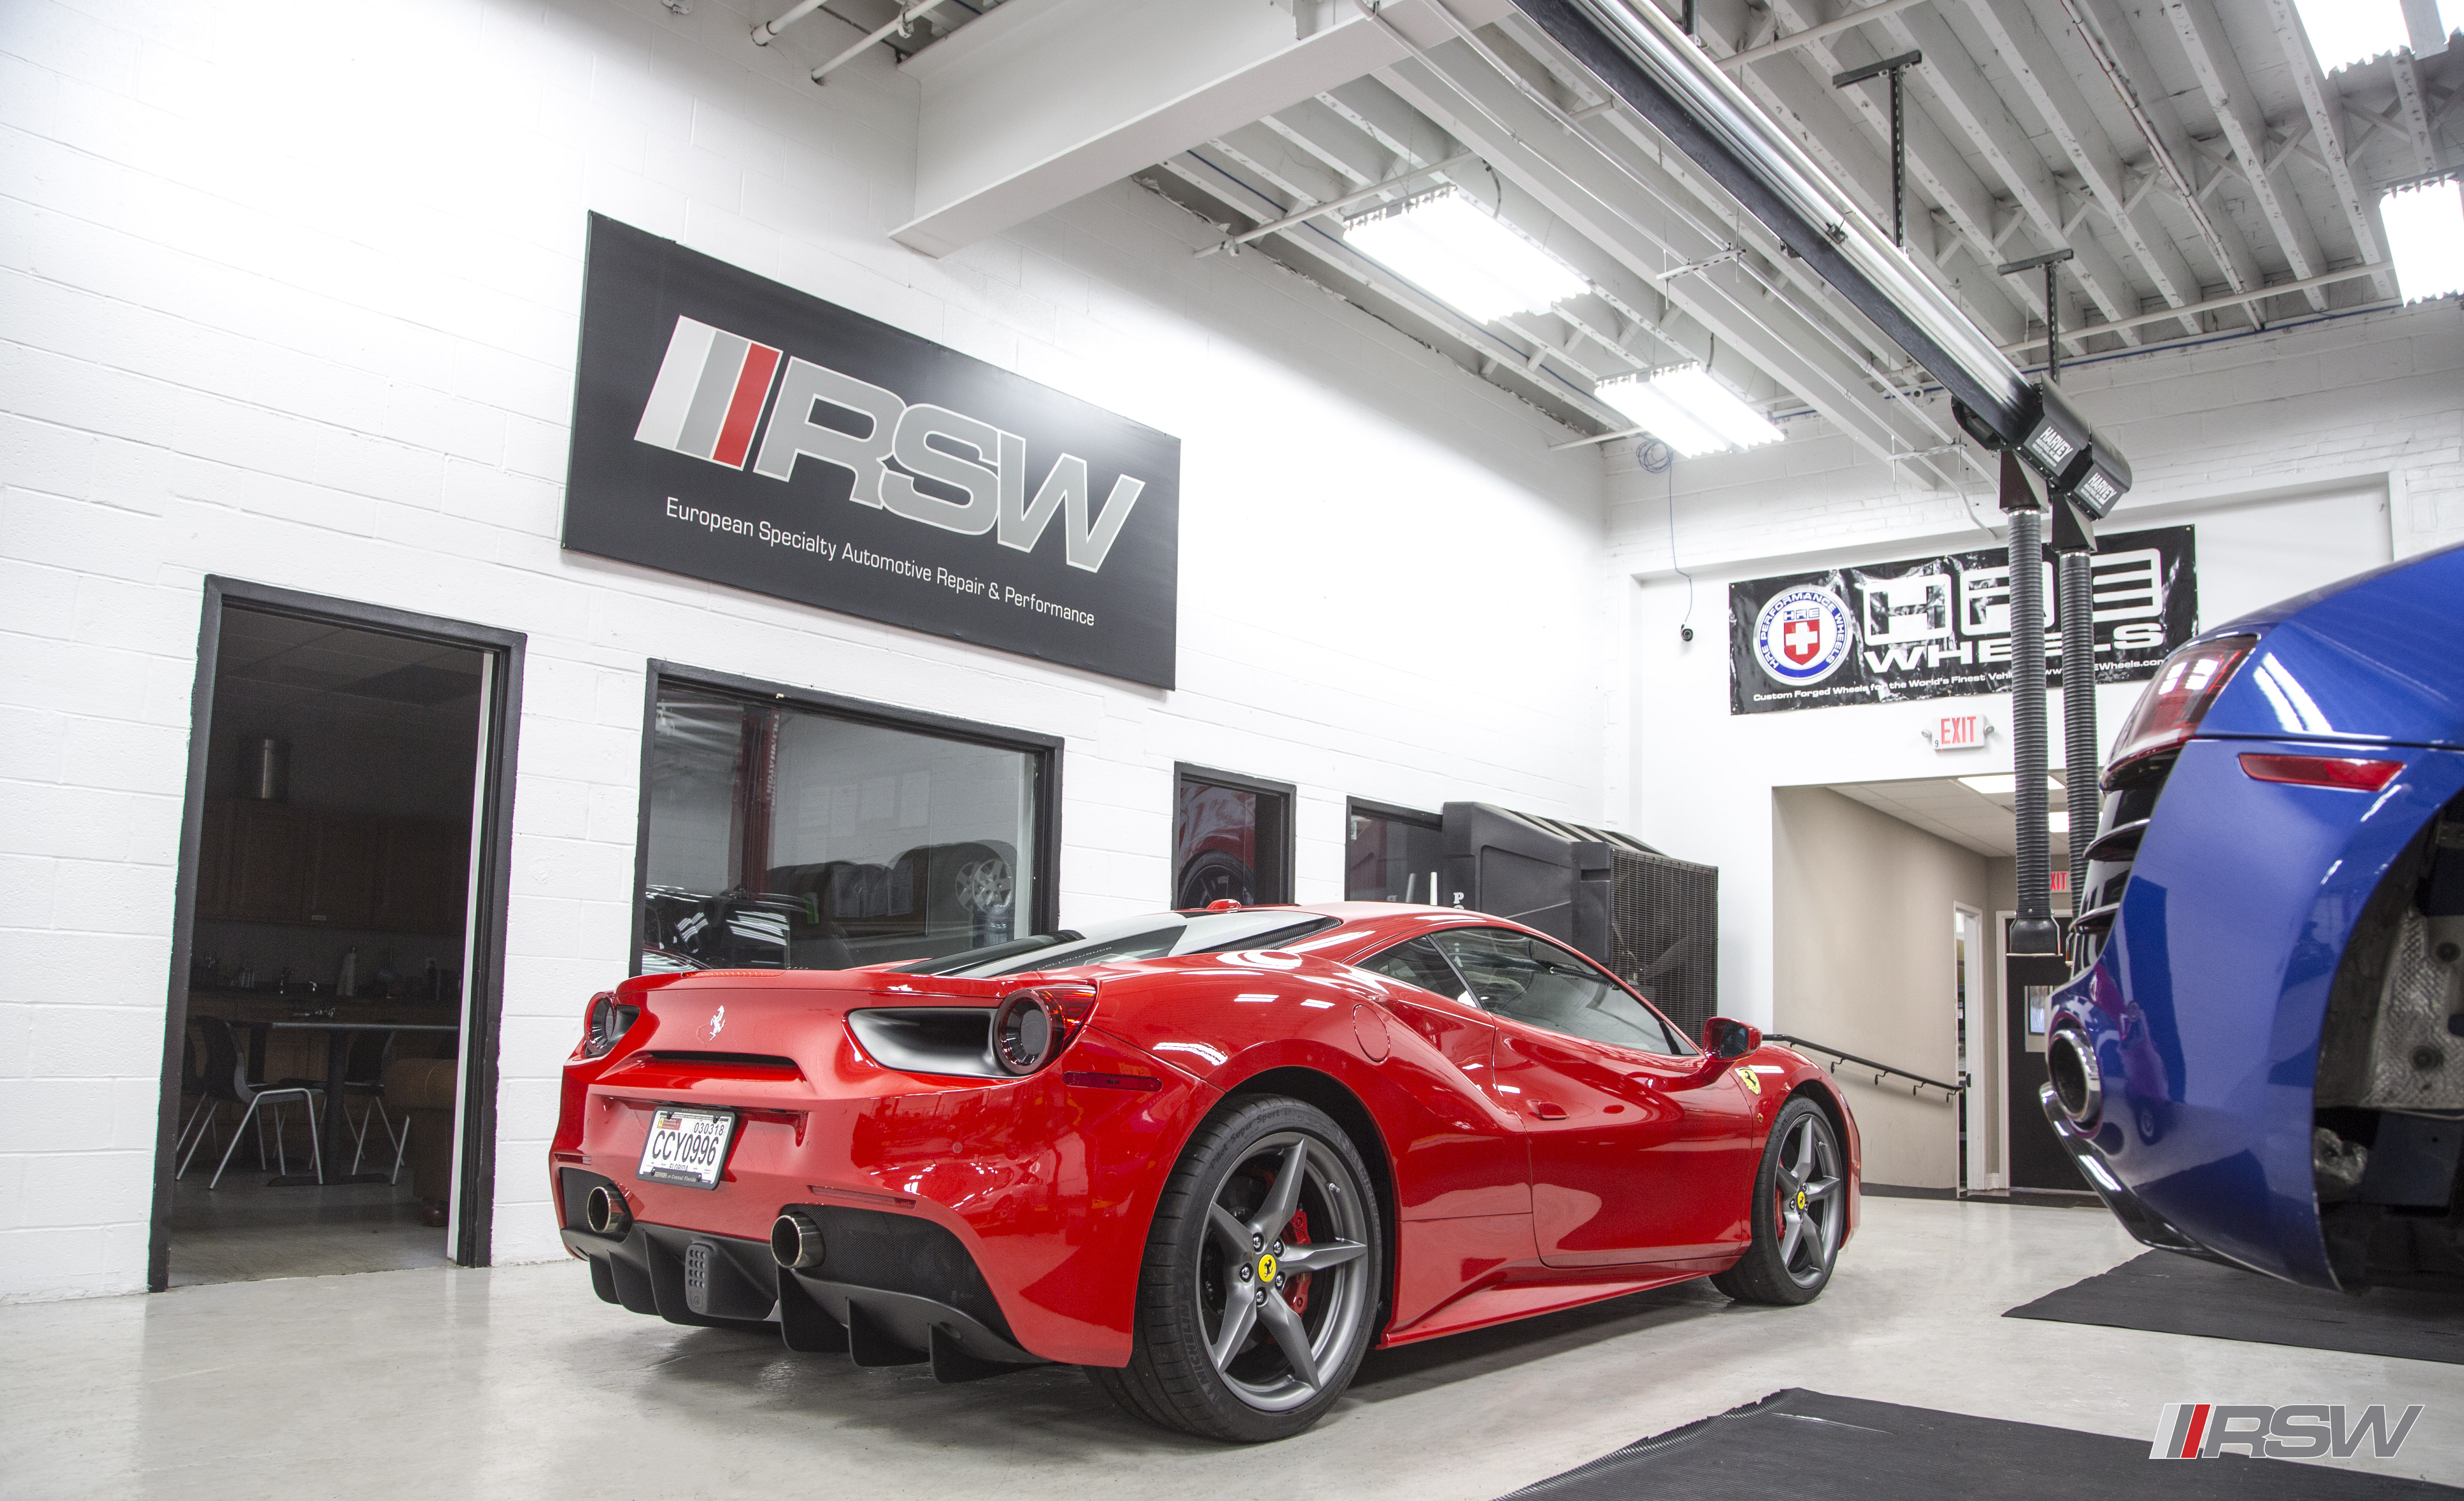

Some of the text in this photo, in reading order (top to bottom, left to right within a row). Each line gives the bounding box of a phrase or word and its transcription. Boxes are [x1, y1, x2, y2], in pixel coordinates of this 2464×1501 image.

[2040, 426, 2074, 462] HARVEY
[754, 356, 1145, 573] RSW
[2087, 472, 2117, 505] HARVEY
[666, 496, 1095, 626] European Specialty Automotive Repair & Performance
[1760, 592, 1845, 669] HRE PERFORMANCE WHEELS
[1784, 608, 1820, 621] HRE
[1864, 622, 2163, 673] WHES
[1753, 691, 1793, 701] Custom
[1794, 687, 1831, 698] Forged
[1832, 685, 1869, 695] Wheels
[1870, 683, 1887, 691] for
[1889, 680, 1907, 689] the
[1909, 677, 1950, 688] World's
[1951, 673, 1986, 684] Finest
[1941, 716, 1976, 744] EXIT
[2051, 872, 2067, 890] XIT
[694, 1122, 725, 1136] 030318
[1230, 1121, 1254, 1144] Super
[1256, 1109, 1280, 1124] Sport
[652, 1130, 719, 1166] CCY0996
